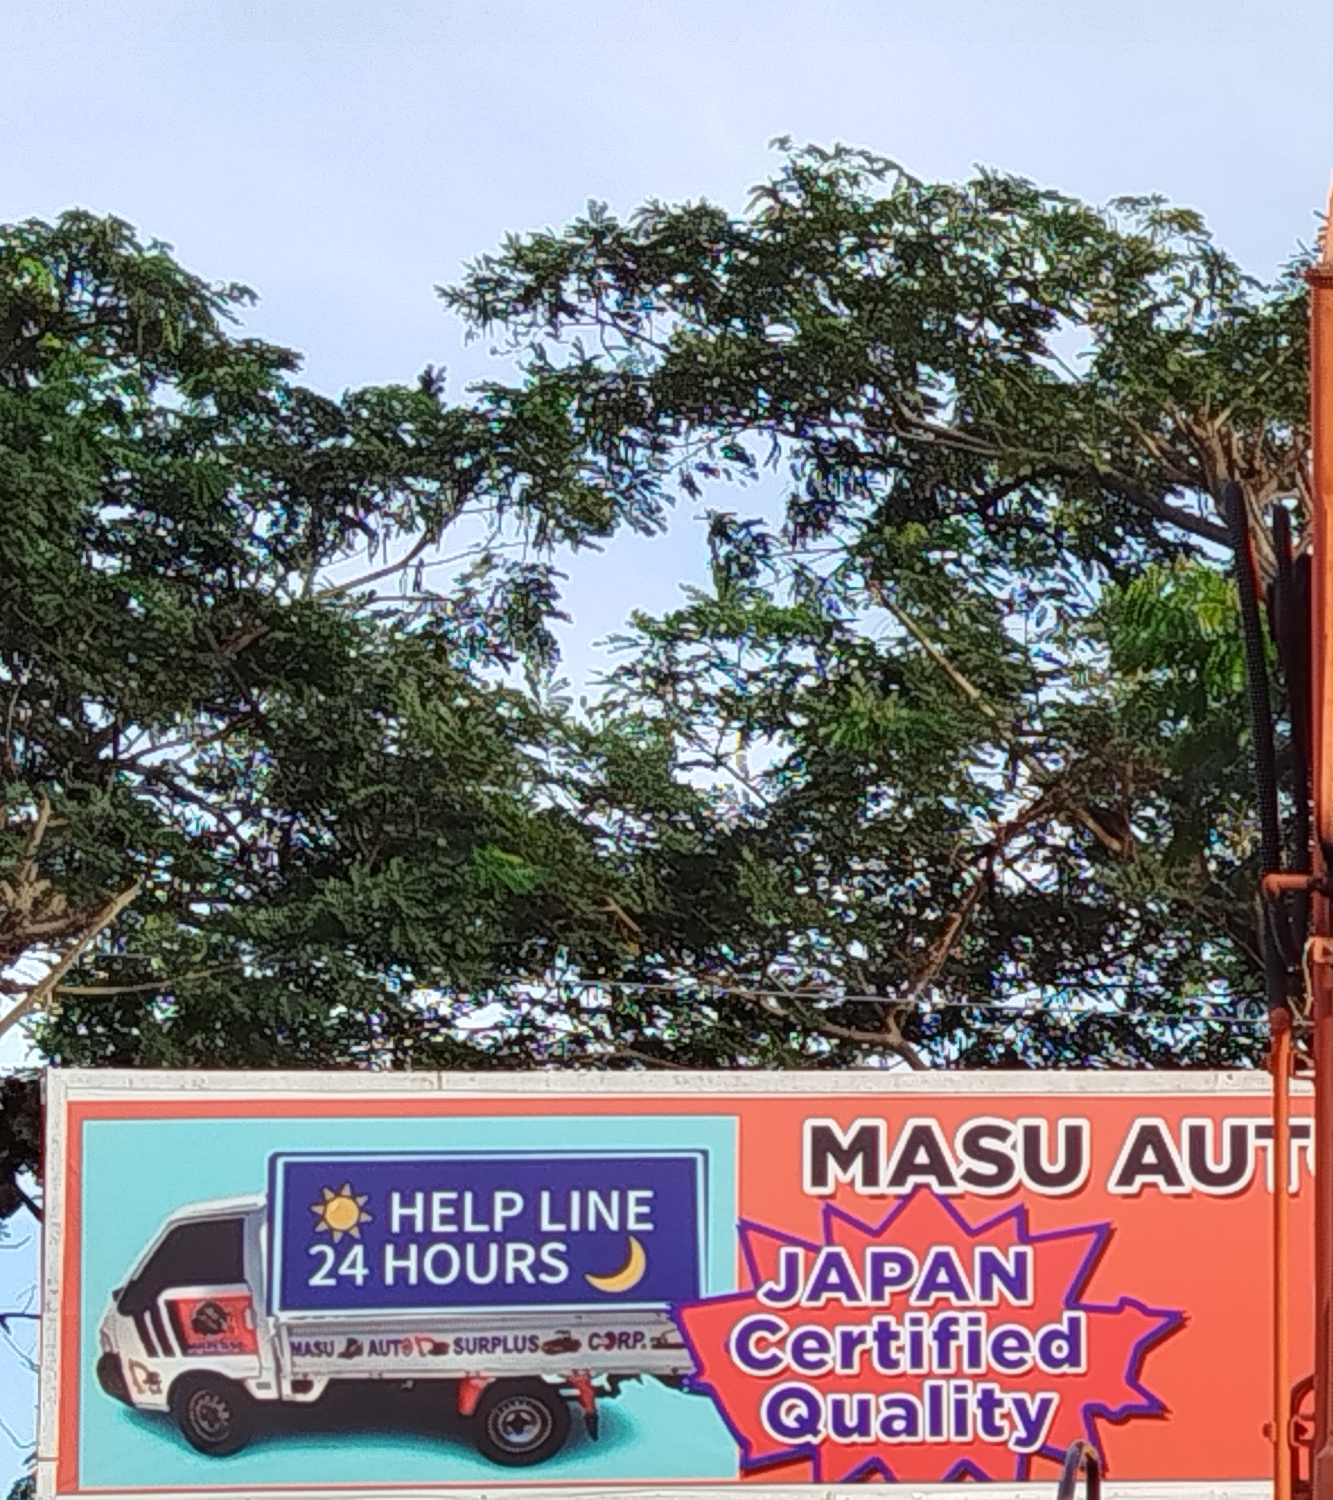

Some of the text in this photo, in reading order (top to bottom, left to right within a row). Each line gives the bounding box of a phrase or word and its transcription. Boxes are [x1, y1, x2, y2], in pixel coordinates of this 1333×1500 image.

[803, 1116, 1091, 1195] MASU
[1108, 1116, 1315, 1195] AUT
[390, 1189, 654, 1234] HELP LINE
[308, 1240, 569, 1288] 24 HOURS
[757, 1246, 1033, 1306] JAPAN
[290, 1330, 647, 1359] MASU AUTO SURPLUS CORP.
[731, 1308, 1086, 1375] Certified
[761, 1381, 1059, 1450] Quality
